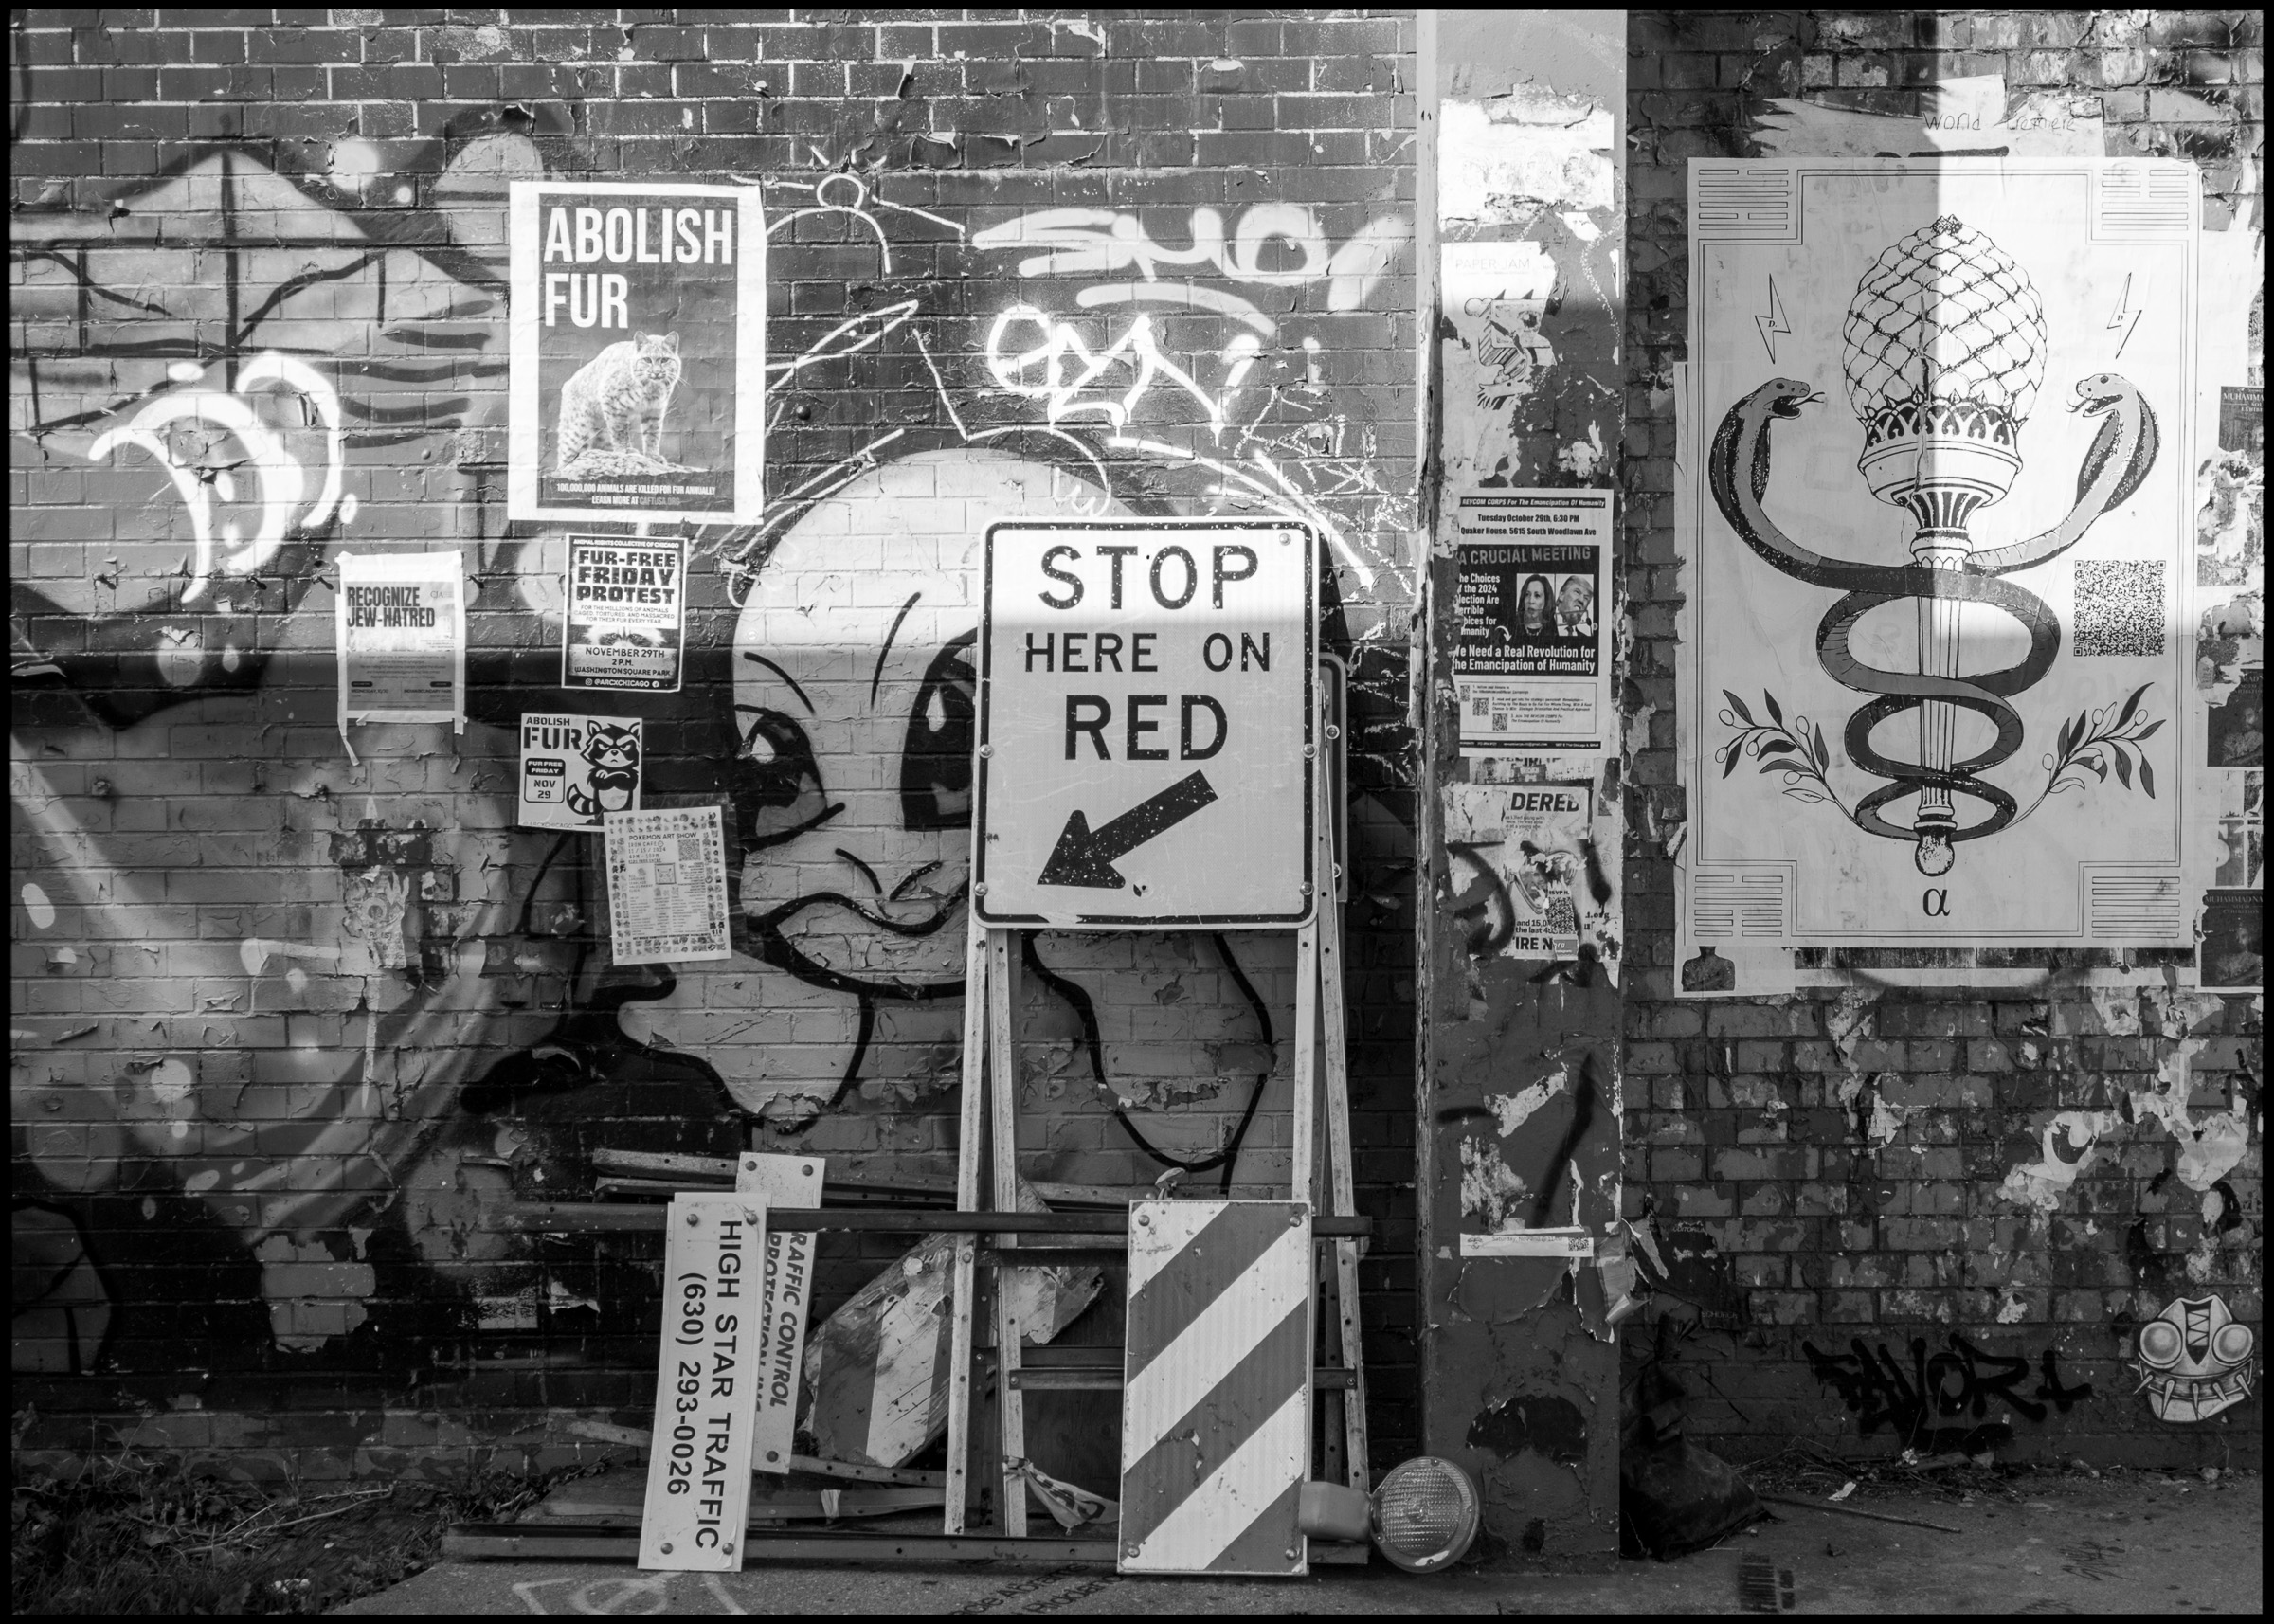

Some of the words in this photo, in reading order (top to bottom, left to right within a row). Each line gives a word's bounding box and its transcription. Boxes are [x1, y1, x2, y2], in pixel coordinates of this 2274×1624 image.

[1922, 112, 1981, 131] World
[544, 207, 732, 264] ABOLISH
[1455, 259, 1497, 270] PAPER
[1501, 259, 1530, 270] JAM
[545, 273, 628, 329] FUR
[557, 483, 596, 493] 100,000,000
[597, 484, 624, 493] ANIMALS
[625, 485, 637, 493] ARE
[638, 485, 659, 494] KILLED
[659, 486, 671, 494] FOR
[672, 486, 684, 494] FUR
[685, 486, 716, 495] ANNUALLY
[592, 496, 612, 505] LEARN
[613, 496, 630, 505] MORE
[631, 496, 639, 505] AT
[1478, 514, 1506, 523] Tuesday
[1535, 515, 1552, 523] 29th,
[1461, 527, 1484, 535] Quaker
[1527, 527, 1546, 535] South
[578, 550, 675, 567] FUR-FREE
[1459, 551, 1467, 565] A
[1471, 549, 1528, 565] CRUCIAL
[1532, 546, 1591, 561] MEETING
[578, 566, 675, 586] FRIDAY
[1038, 545, 1259, 610] STOP
[1459, 573, 1469, 583] he
[1470, 573, 1500, 583] Choices
[347, 587, 420, 607] RECOGNIZE
[576, 585, 674, 604] PROTEST
[1464, 584, 1476, 593] the
[1478, 584, 1497, 593] 2024
[1459, 594, 1484, 604] lection
[1486, 595, 1499, 604] Are
[347, 608, 435, 628] JEW-HATRED
[1459, 605, 1484, 614] errible
[1464, 616, 1484, 625] oices
[1485, 616, 1497, 625] for
[1462, 626, 1489, 638] manity
[585, 647, 639, 657] NOVEMBER
[641, 650, 665, 658] 29TH
[1025, 632, 1158, 672] HERE
[1203, 632, 1270, 672] ON
[1469, 644, 1493, 657] Need
[1495, 647, 1501, 657] a
[1504, 645, 1525, 657] Real
[1527, 646, 1578, 658] Revolution
[1580, 646, 1595, 658] for
[1455, 658, 1466, 670] he
[1469, 658, 1534, 673] Emancipation
[1537, 659, 1547, 670] of
[1549, 659, 1595, 674] Humanity
[594, 679, 650, 687] @ARCXCHICAGO
[526, 717, 570, 726] ABOLISH
[1065, 695, 1228, 761] RED
[523, 726, 582, 750] FUR
[534, 780, 556, 788] NOV
[538, 790, 551, 799] 29
[717, 1220, 743, 1298] HIGH
[782, 1232, 808, 1306] RAFFIC
[674, 1272, 708, 1347] (630)
[710, 1313, 738, 1398] STAR
[769, 1311, 797, 1407] CONTROL
[667, 1361, 702, 1496] 293-0026
[695, 1412, 731, 1550] TRAFFIC
